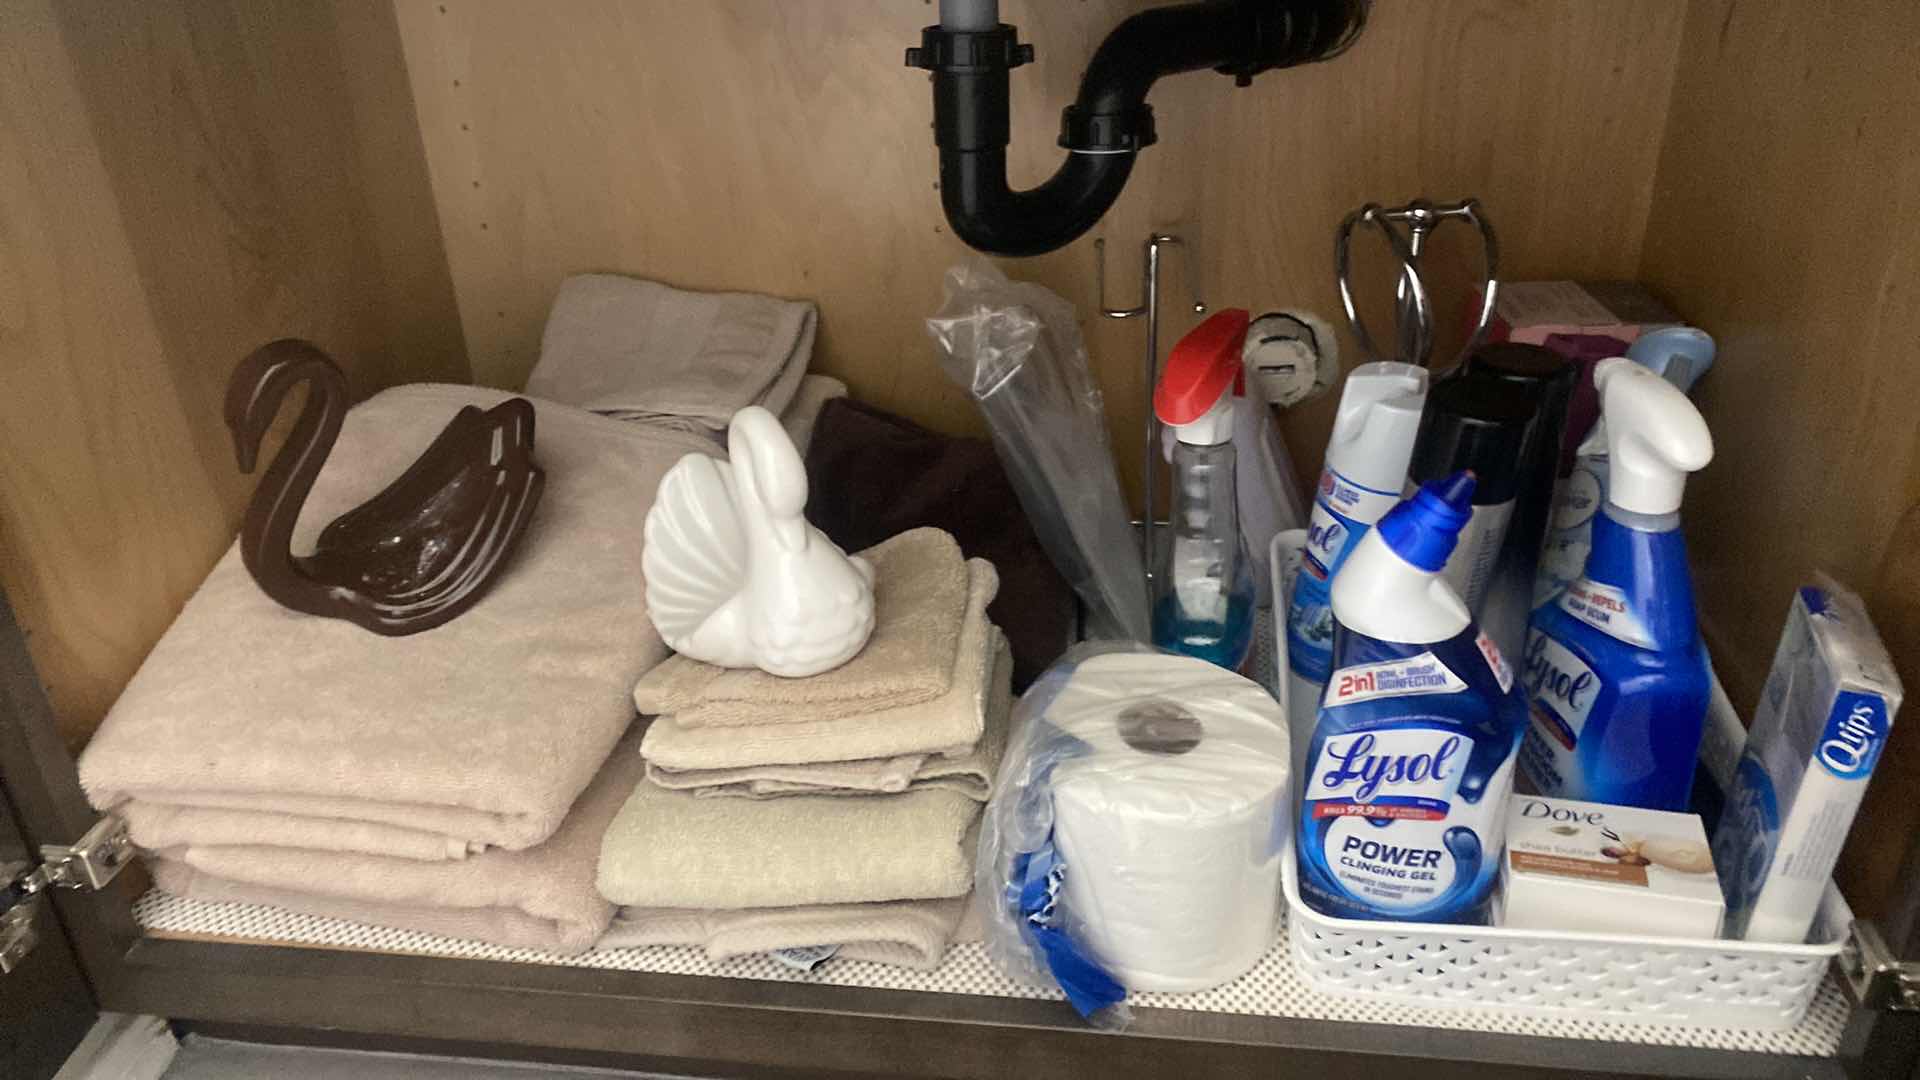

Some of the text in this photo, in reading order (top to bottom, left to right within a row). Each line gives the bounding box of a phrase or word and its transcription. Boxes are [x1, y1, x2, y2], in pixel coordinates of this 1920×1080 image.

[1338, 671, 1376, 697] 2in1
[1322, 733, 1460, 801] Lysol
[1522, 801, 1605, 826] Dove
[1342, 835, 1443, 869] POWER
[1340, 856, 1437, 881] CLINGING GEL
